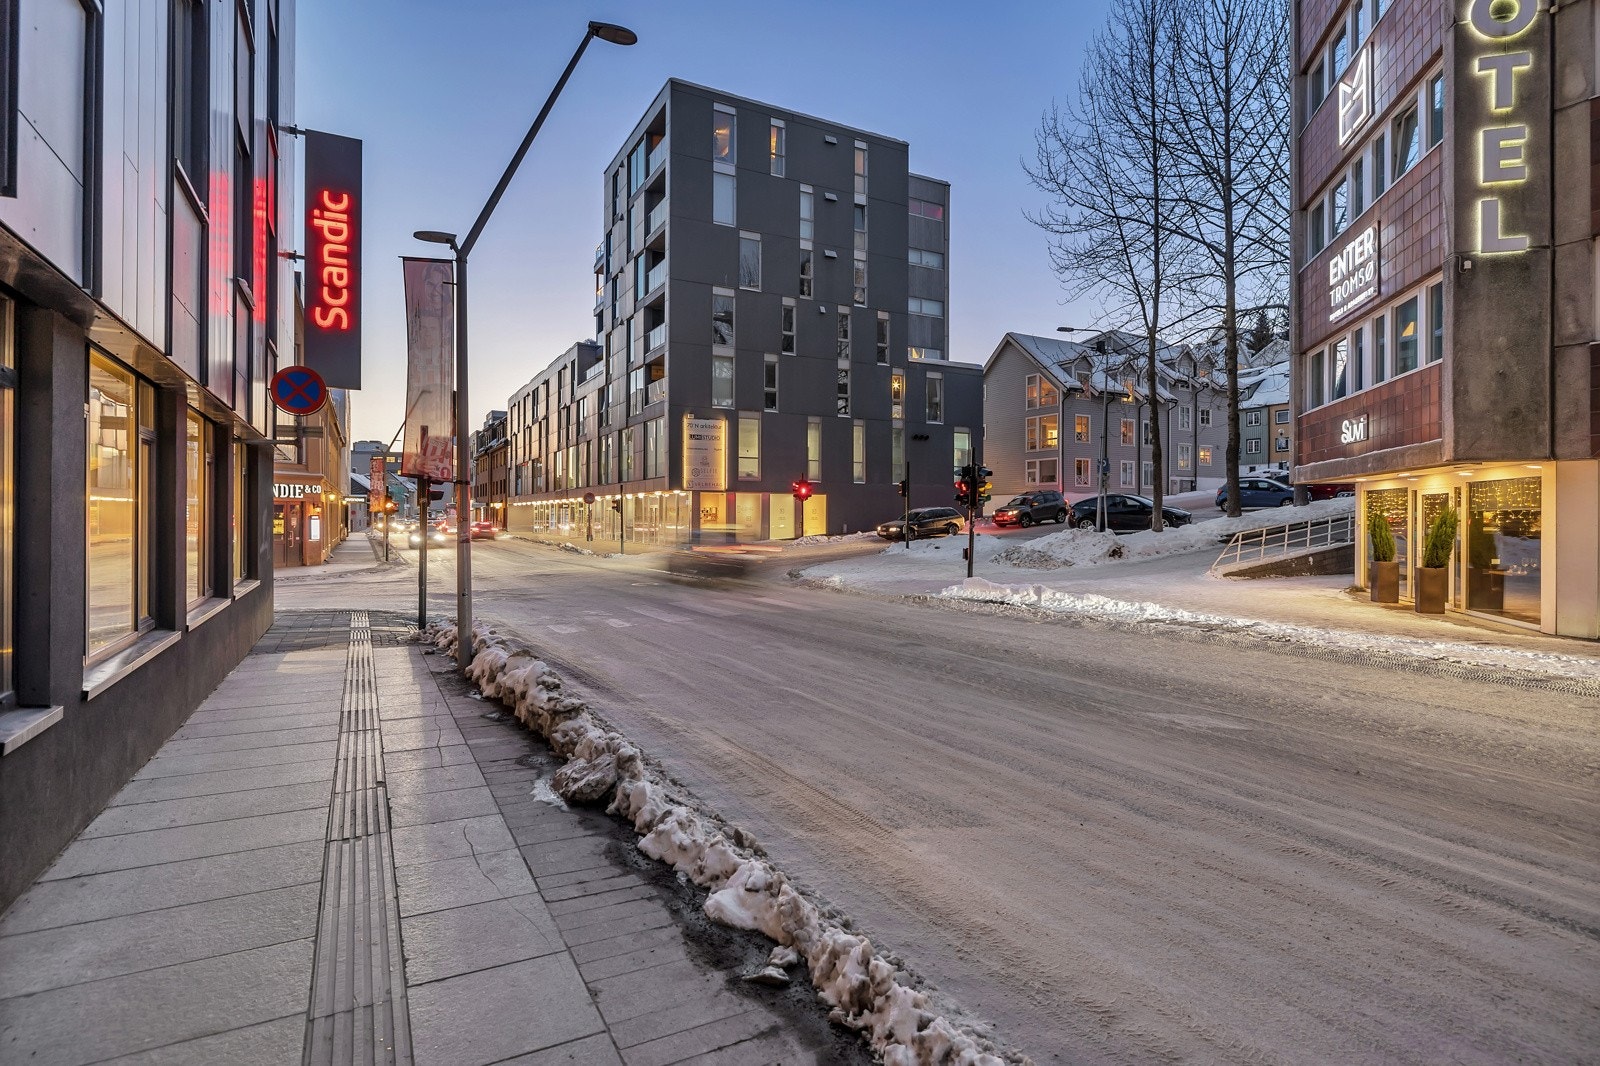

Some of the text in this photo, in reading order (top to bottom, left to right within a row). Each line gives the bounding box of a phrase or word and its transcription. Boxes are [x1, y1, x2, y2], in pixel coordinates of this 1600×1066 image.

[1470, 0, 1539, 254] OTEL
[313, 190, 348, 330] Scandic
[1329, 226, 1374, 287] ENTER
[1329, 260, 1374, 307] TROMSØ
[304, 485, 312, 494] &
[312, 485, 322, 494] CO
